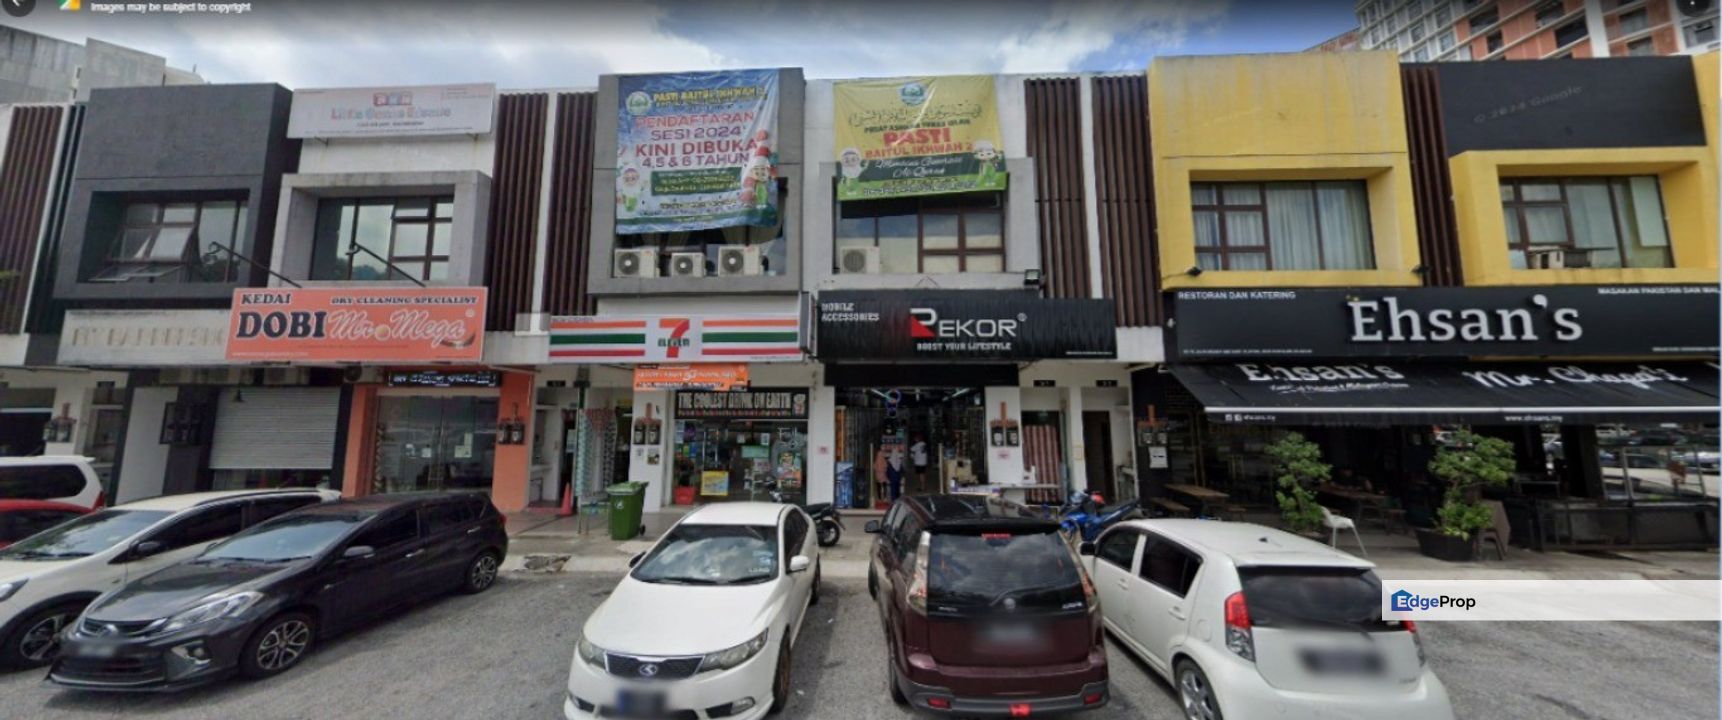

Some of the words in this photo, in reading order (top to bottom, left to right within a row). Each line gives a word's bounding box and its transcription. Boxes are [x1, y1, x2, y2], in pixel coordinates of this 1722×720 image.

[635, 111, 754, 129] PENDAFTARAN
[651, 127, 690, 142] SESI
[694, 126, 743, 140] 2024
[883, 127, 952, 146] PASTI
[635, 143, 676, 158] KINI
[682, 138, 758, 156] DIBUKA
[864, 145, 909, 159] BAITUL
[912, 142, 962, 155] IKHWAH
[667, 156, 679, 167] &
[682, 155, 692, 167] 6
[695, 153, 750, 166] TAHUN
[241, 293, 291, 305] KEDAI
[356, 296, 412, 304] CLEANING
[414, 295, 477, 304] SPECIALIST
[1177, 291, 1228, 300] RESTORAN
[1229, 291, 1249, 300] DAN
[1250, 291, 1296, 300] KATERING
[821, 302, 855, 312] MOBILE
[821, 312, 880, 322] ACCESSORIES
[1347, 294, 1583, 342] Ehsan's
[236, 311, 327, 338] DOBI
[390, 309, 466, 349] Mega
[659, 318, 691, 358] 7
[916, 342, 943, 351] BOOST
[945, 342, 967, 351] YOUR
[968, 342, 1012, 351] LIFESTYLE
[678, 392, 694, 409] THE
[694, 391, 728, 409] COOLEST
[729, 391, 752, 409] DRINK
[754, 391, 765, 409] ON
[766, 391, 791, 409] EARTH
